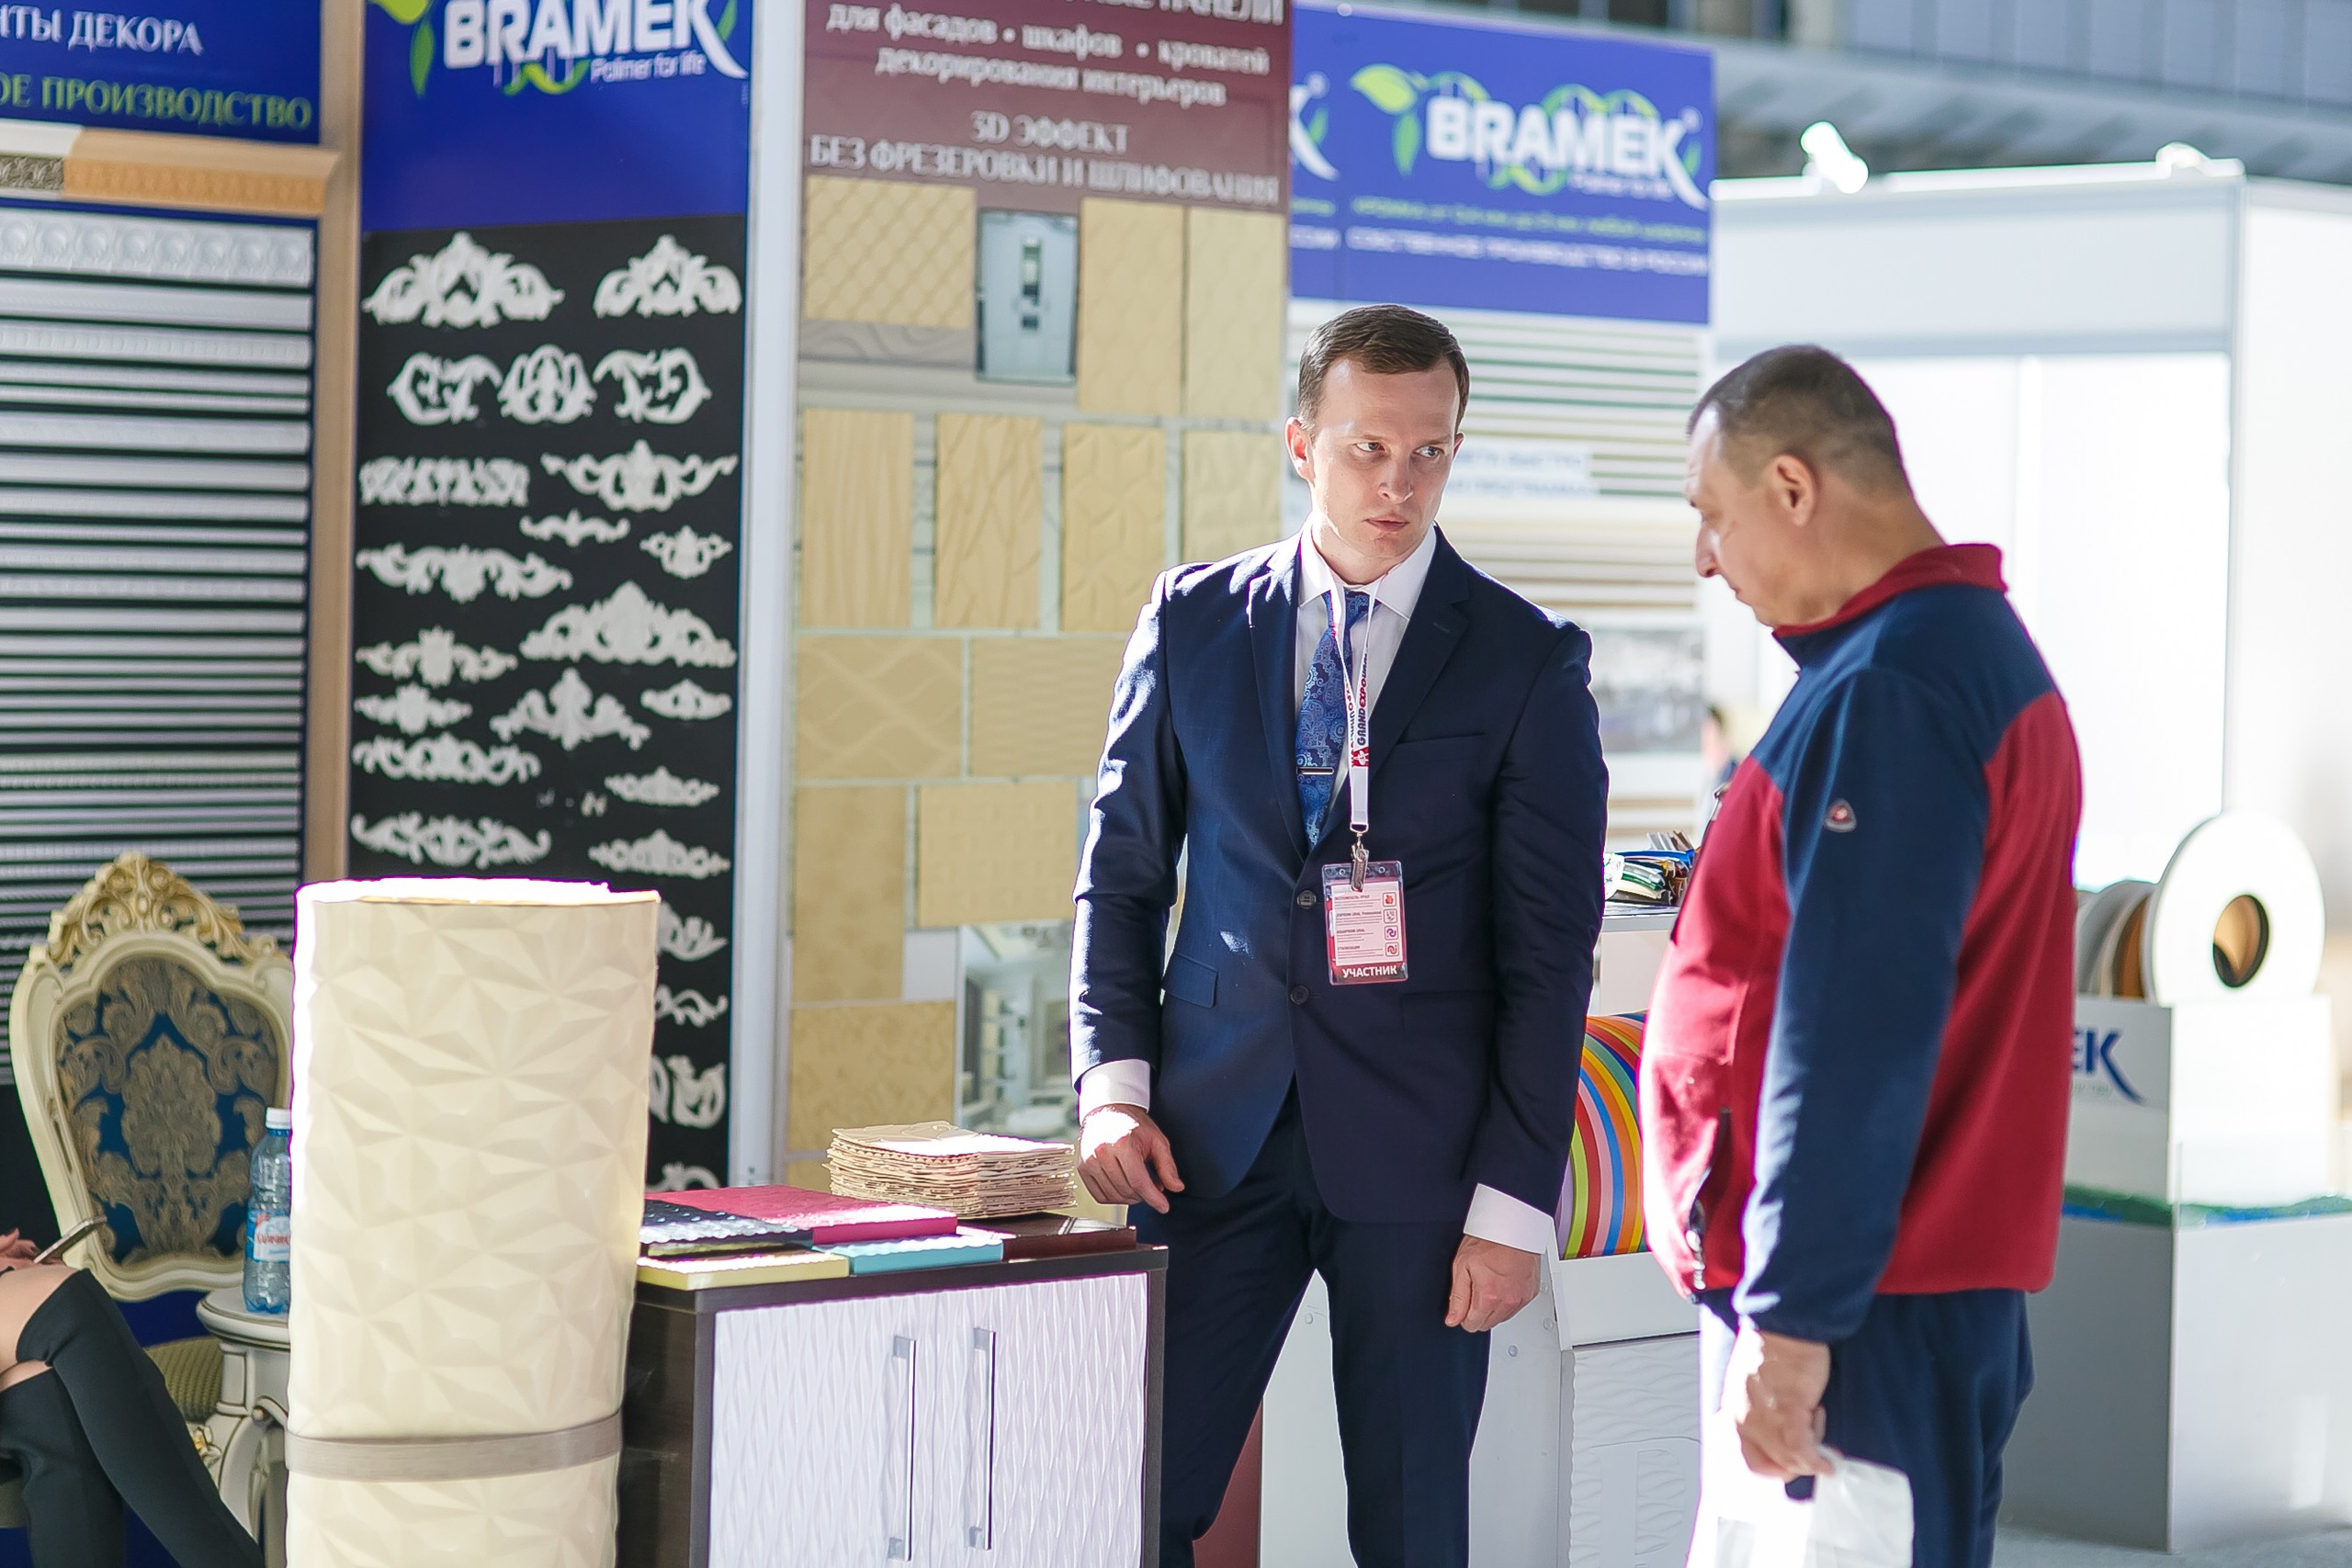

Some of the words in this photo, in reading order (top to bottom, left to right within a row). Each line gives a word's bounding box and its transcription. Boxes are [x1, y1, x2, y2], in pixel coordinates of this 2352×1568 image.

[68, 10, 204, 56] ДЕКОРА
[444, 0, 749, 79] BRAMEK
[826, 3, 879, 33] для
[884, 2, 998, 45] фасадов
[1022, 23, 1123, 62] шкафов
[41, 76, 312, 130] ПРОИЗВОДСТВО
[809, 133, 866, 170] БЕЗ
[1425, 95, 1709, 211] BRAMEK
[1342, 965, 1397, 978] УЧАСТНИК
